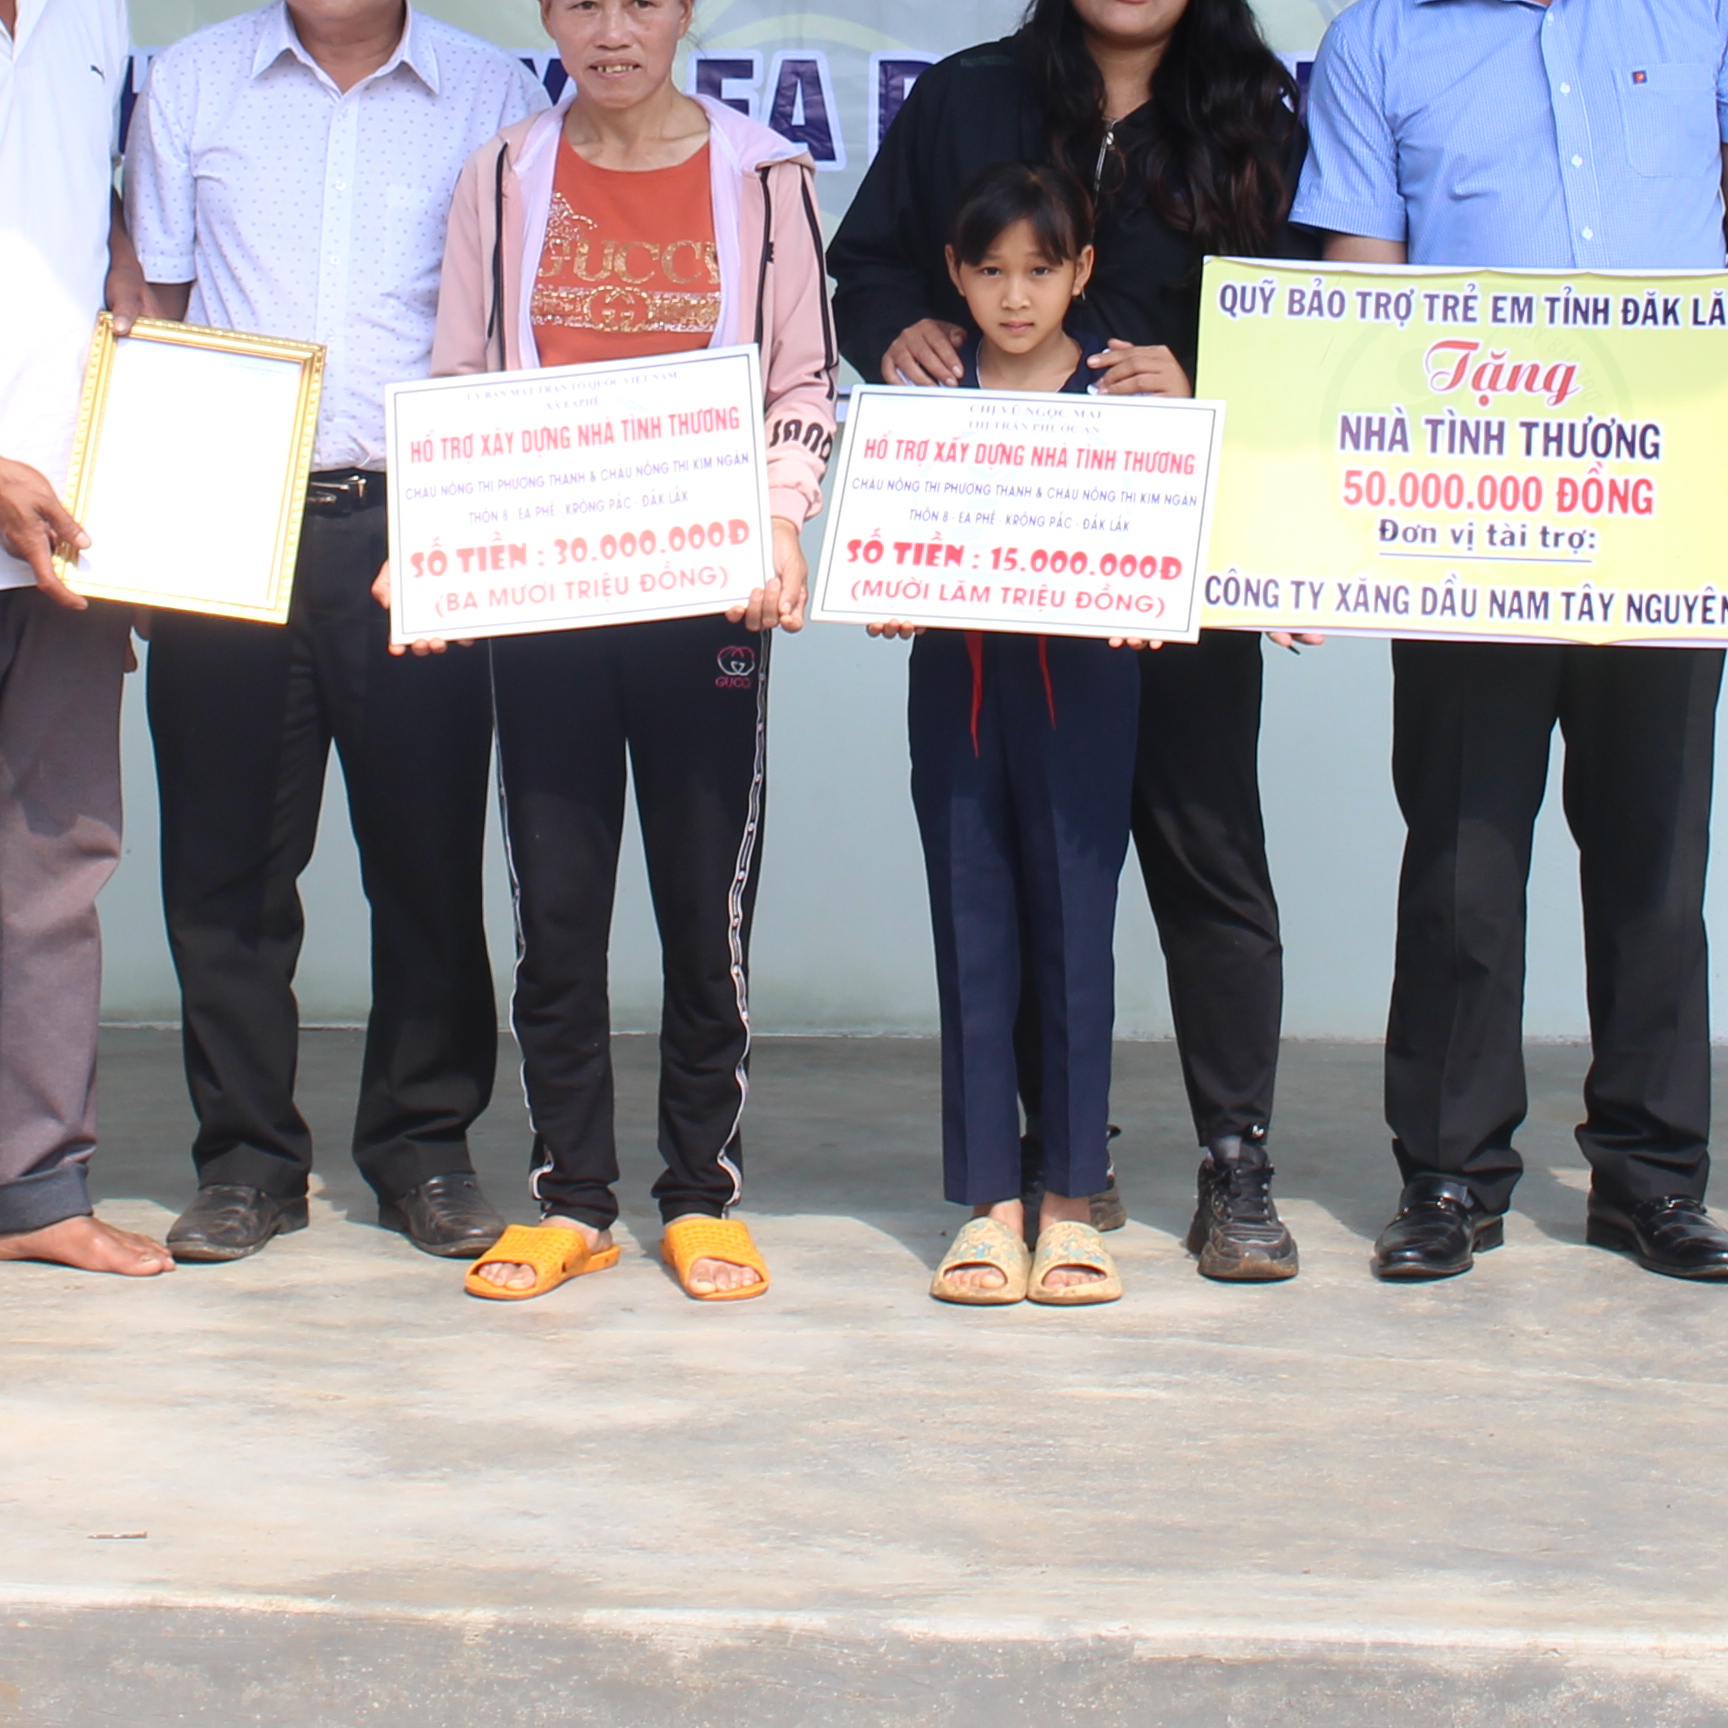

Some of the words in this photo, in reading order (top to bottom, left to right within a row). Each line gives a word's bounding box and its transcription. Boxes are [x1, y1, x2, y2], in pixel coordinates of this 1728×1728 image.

[1219, 278, 1275, 317] QUỸ
[1287, 277, 1346, 319] BẢO
[1356, 287, 1415, 328] TRỢ
[1424, 282, 1478, 323] TRẺ
[1491, 294, 1534, 324] EM
[1545, 285, 1610, 326] TỈNH
[1621, 290, 1680, 327] ĐĂK
[1426, 341, 1582, 406] Tặng
[440, 432, 475, 465] TRỢ
[521, 423, 572, 460] DỰNG
[577, 416, 615, 448] NHÀ
[620, 412, 663, 443] TÌNH
[668, 405, 741, 437] THƯƠNG
[895, 437, 932, 467] TRỢ
[974, 440, 1025, 471] DỰNG
[1030, 441, 1069, 469] NHÀ
[1076, 443, 1117, 471] TÌNH
[1124, 449, 1196, 476] THƯƠNG
[1339, 407, 1409, 453] NHÀ
[1424, 409, 1505, 456] TÌNH
[1519, 416, 1661, 460] THƯƠNG
[1343, 470, 1542, 512] 50.000.000
[1556, 461, 1654, 515] ĐỒNG
[409, 535, 449, 579] SỐ
[455, 529, 528, 574] TIỀN
[553, 519, 751, 566] 30.000.000Đ
[846, 527, 885, 565] SỐ
[892, 530, 966, 568] TIỀN
[990, 545, 1184, 582] 15.000.000Đ
[1379, 518, 1437, 545] Đơn
[1449, 524, 1474, 551] vị
[1485, 521, 1528, 547] tài
[1539, 526, 1596, 552] trợ:
[435, 590, 479, 619] (BA
[488, 581, 555, 608] MƯƠI
[564, 571, 630, 604] TRIỆU
[639, 560, 729, 593] ĐỒNG)
[850, 576, 931, 602] (MƯỜI
[938, 579, 992, 604] LĂM
[1000, 582, 1067, 614] TRIỆU
[1074, 582, 1167, 620] ĐỒNG)
[1204, 568, 1280, 609] CÔNG
[1290, 580, 1325, 612] TY
[1335, 576, 1410, 616] XĂNG
[1421, 572, 1478, 618] DẦU
[1488, 588, 1550, 622] NAM
[1560, 582, 1616, 623] TÂY
